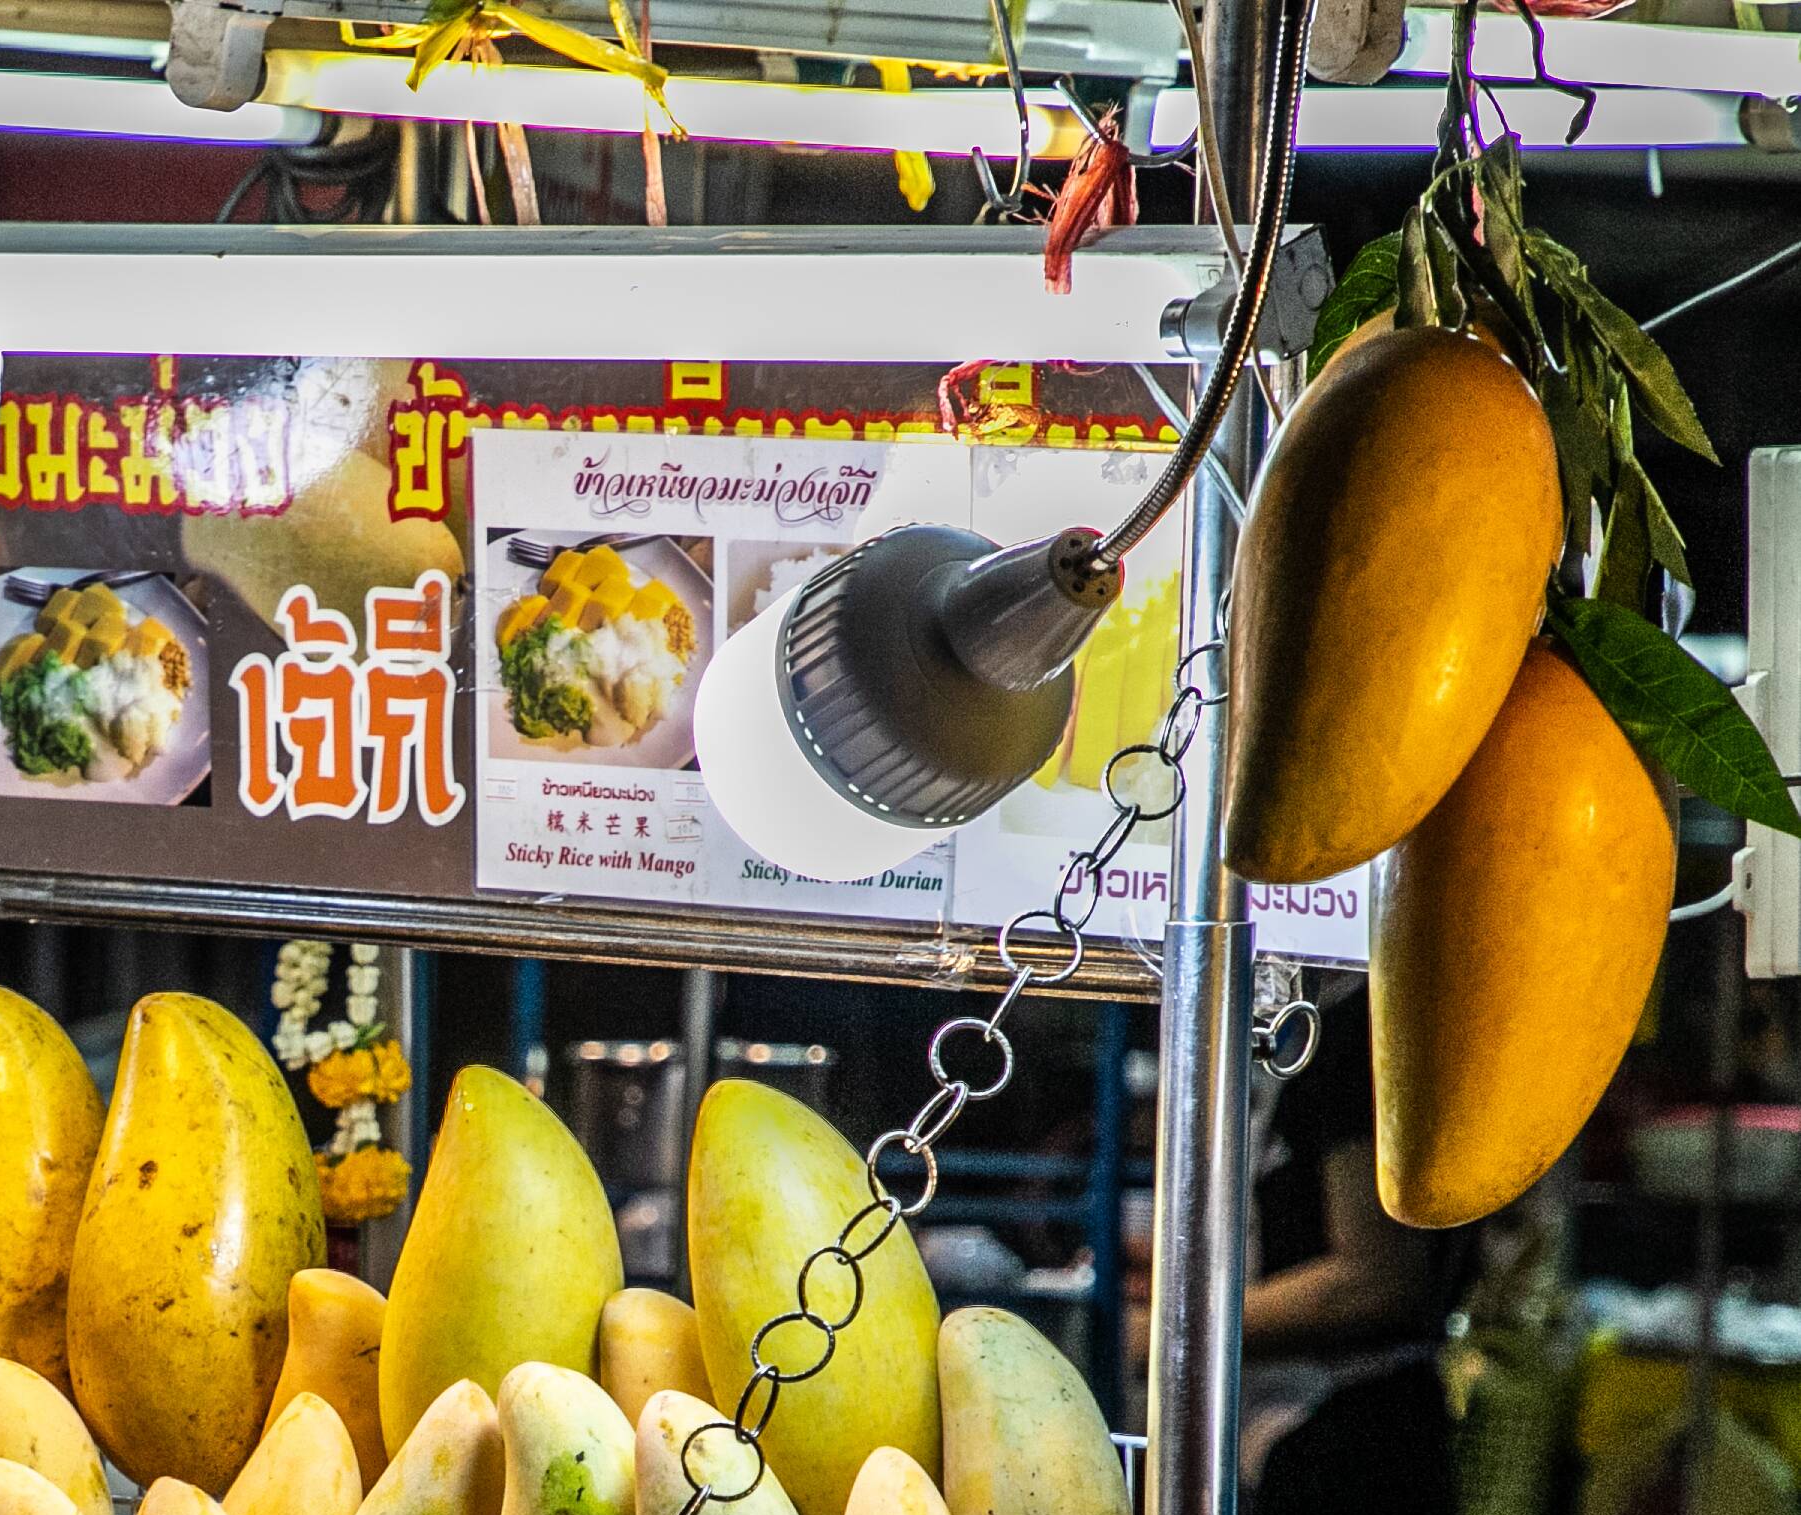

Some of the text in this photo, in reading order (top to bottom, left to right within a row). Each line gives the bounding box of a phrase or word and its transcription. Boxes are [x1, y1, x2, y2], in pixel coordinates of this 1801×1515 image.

[505, 842, 696, 879] Sticky Rice with Mango
[741, 858, 792, 886] Sticky
[879, 868, 944, 892] Durian
